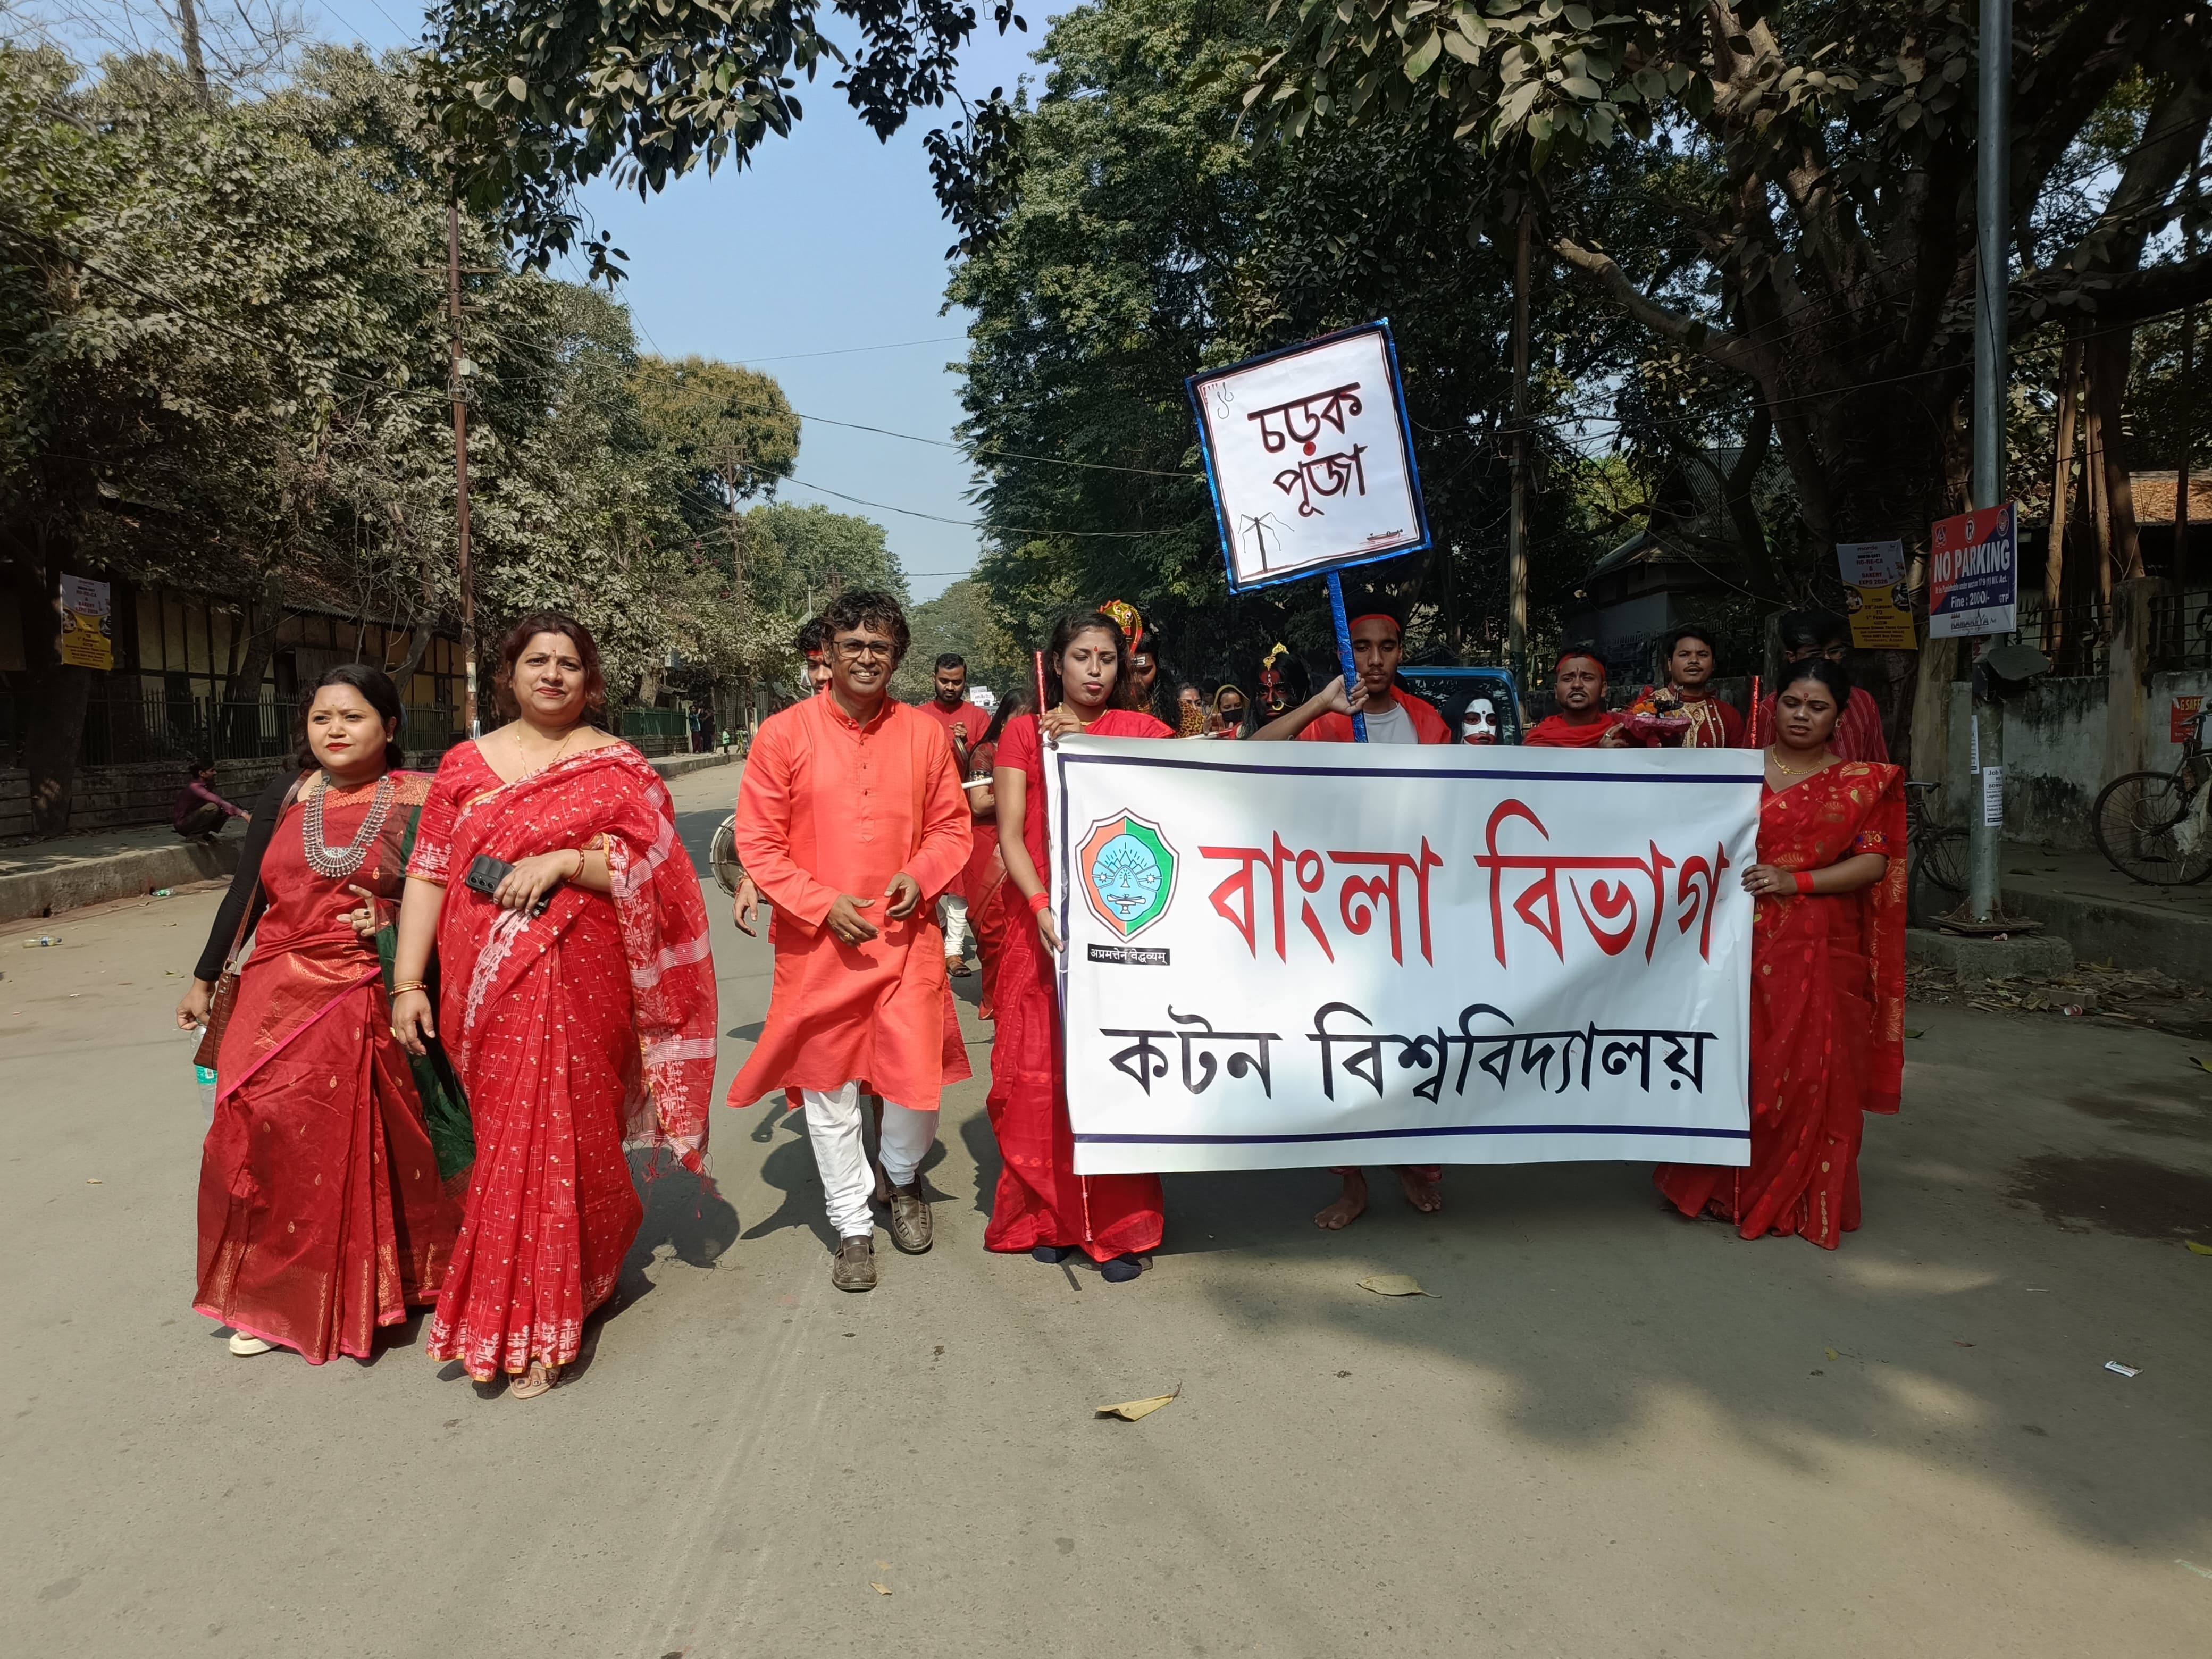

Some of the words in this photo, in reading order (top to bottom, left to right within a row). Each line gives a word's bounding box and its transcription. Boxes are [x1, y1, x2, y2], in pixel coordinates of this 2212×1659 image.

[1247, 382, 1362, 456] চড়ক
[1273, 443, 1368, 517] পূজা
[1934, 551, 1951, 583] NO
[1955, 539, 2010, 579] PARKING
[1950, 596, 1965, 609] Fine
[1197, 830, 1444, 967] বাংলা
[1473, 798, 1730, 969] বিভাগ
[1090, 947, 1128, 960] अप्रमत्तेन
[1099, 1003, 1283, 1100] কটন
[1305, 1001, 1718, 1105] বিশ্ববিদ্যালয়
